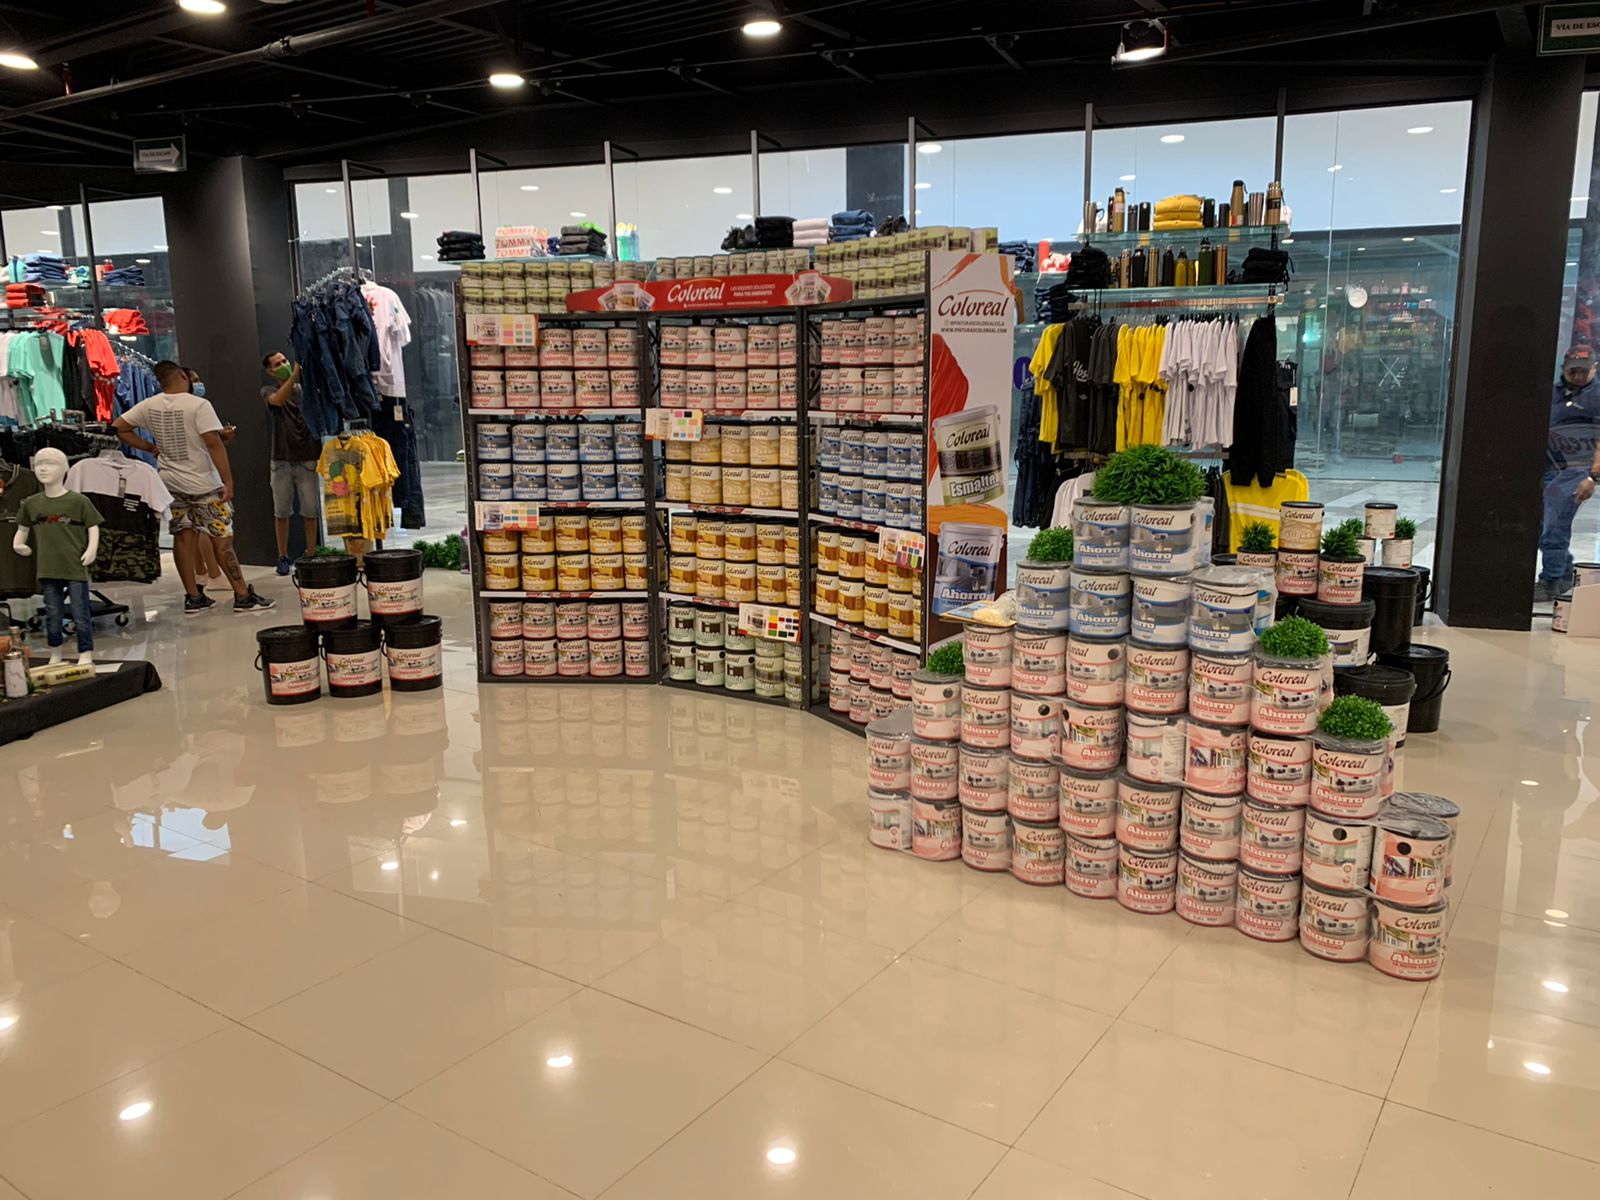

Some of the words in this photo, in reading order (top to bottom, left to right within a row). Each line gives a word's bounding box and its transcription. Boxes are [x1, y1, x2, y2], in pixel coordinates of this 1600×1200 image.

[667, 282, 725, 302] Coloreal
[938, 294, 1009, 317] Coloreal
[946, 424, 991, 448] Coloreal
[950, 473, 997, 498] Esmalte
[1080, 510, 1122, 521] Coloreal
[1133, 513, 1175, 526] Coloreal
[1285, 510, 1314, 519] Coloreal
[948, 540, 992, 557] Coloreal
[1079, 545, 1121, 553] Ahorro
[1131, 548, 1172, 559] Ahorro
[1285, 555, 1314, 563] Coloreal
[1328, 564, 1358, 572] Coloreal
[1018, 573, 1055, 584] Coloreal
[1078, 580, 1120, 591] Coloreal
[941, 587, 987, 600] Ahorro
[1192, 589, 1232, 604] Coloreal
[1018, 606, 1054, 616] Ahorro
[1077, 613, 1118, 623] Ahorro
[1191, 625, 1230, 637] Ahorro
[1134, 653, 1177, 668] Coloreal
[1195, 661, 1235, 677] Coloreal
[1262, 671, 1310, 686] Coloreal
[963, 693, 1000, 705] Coloreal
[1132, 689, 1176, 702] Ahorro
[1260, 707, 1306, 720] Ahorro
[964, 725, 1000, 736] Ahorro
[914, 748, 949, 759] Coloreal
[1252, 741, 1295, 757] Coloreal
[1319, 753, 1368, 769] Coloreal
[1013, 767, 1049, 779] Coloreal
[1063, 780, 1100, 792] Coloreal
[1250, 777, 1293, 792] Ahorro
[1131, 790, 1173, 806] Coloreal
[1316, 788, 1364, 804] Ahorro
[1061, 812, 1100, 824] Ahorro
[1246, 810, 1290, 826] Coloreal
[1128, 857, 1171, 871] Coloreal
[1183, 865, 1225, 881] Coloreal
[1241, 878, 1285, 895] Coloreal
[1305, 892, 1348, 912] Coloreal
